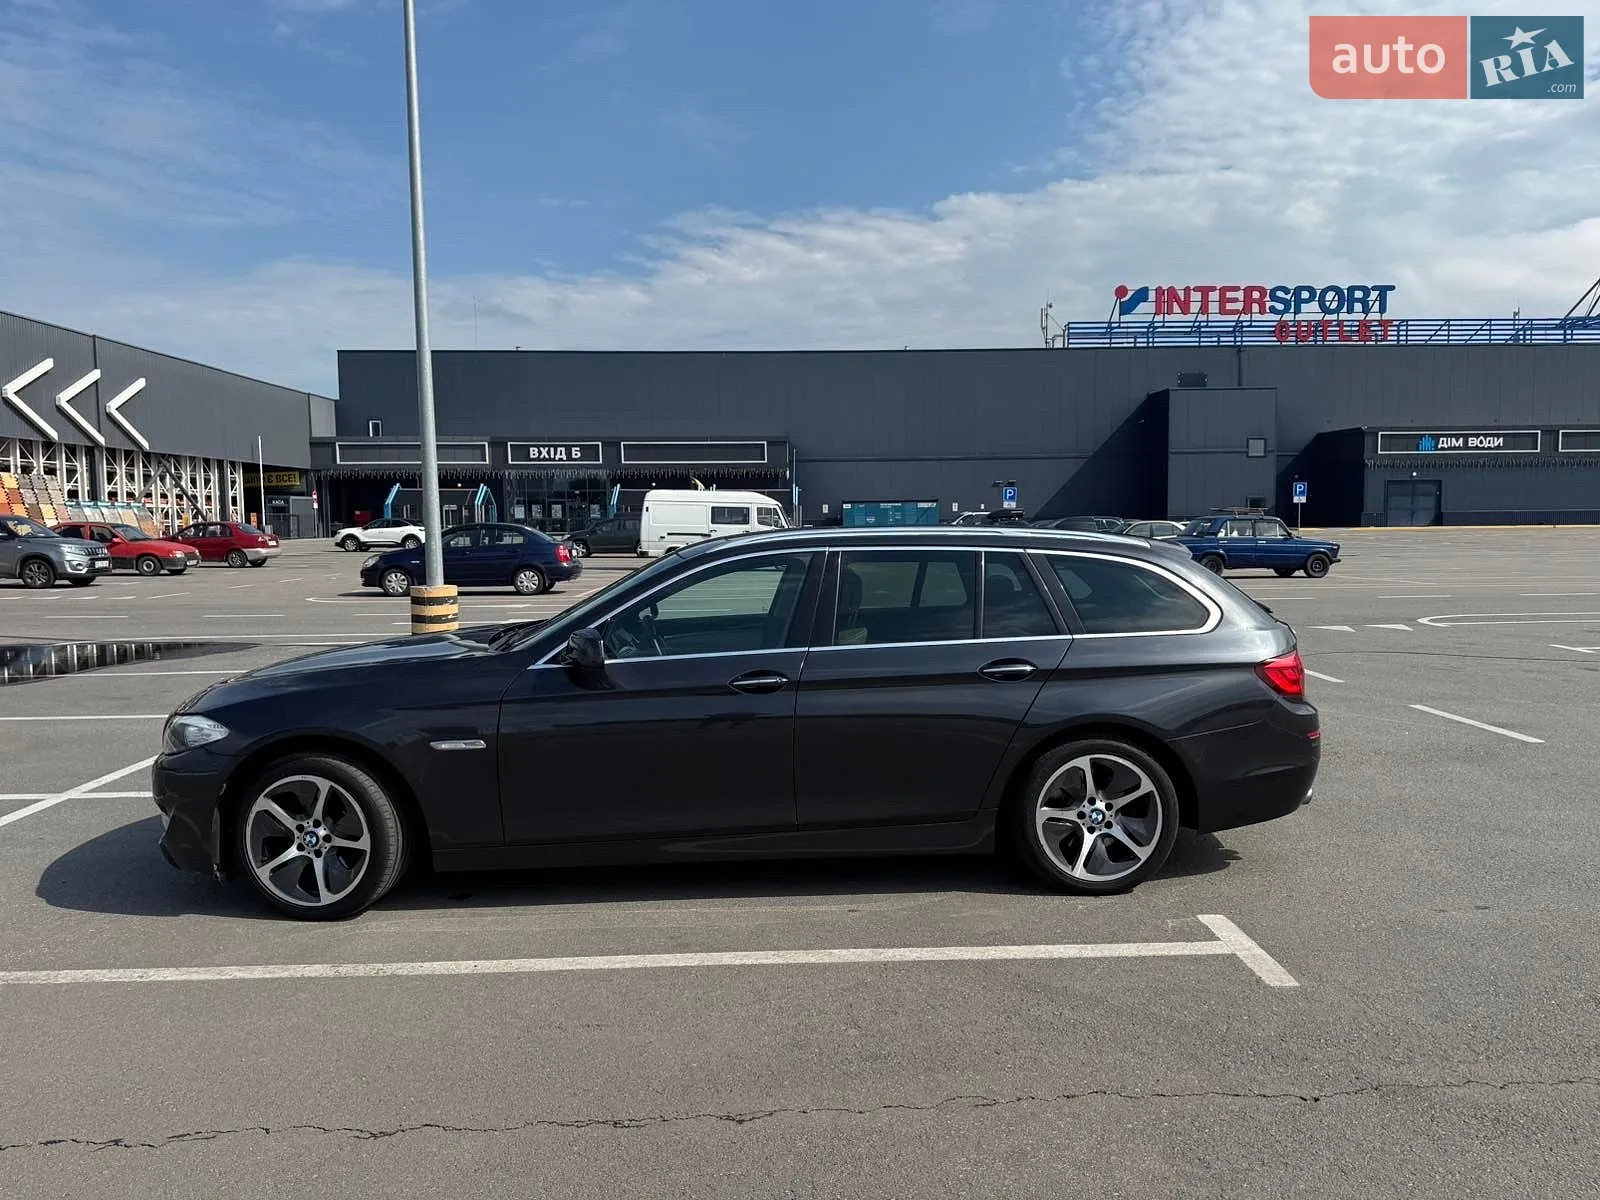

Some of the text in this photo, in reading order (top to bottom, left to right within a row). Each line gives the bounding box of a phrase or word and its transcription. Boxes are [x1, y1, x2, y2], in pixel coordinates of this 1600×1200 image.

[1154, 285, 1397, 316] INTERSPORT
[1274, 319, 1394, 342] OUTLET
[1438, 436, 1504, 448] ДІМ ВОДИ
[529, 447, 581, 460] ВХІД Б
[1006, 489, 1014, 500] P
[1297, 484, 1304, 495] P
